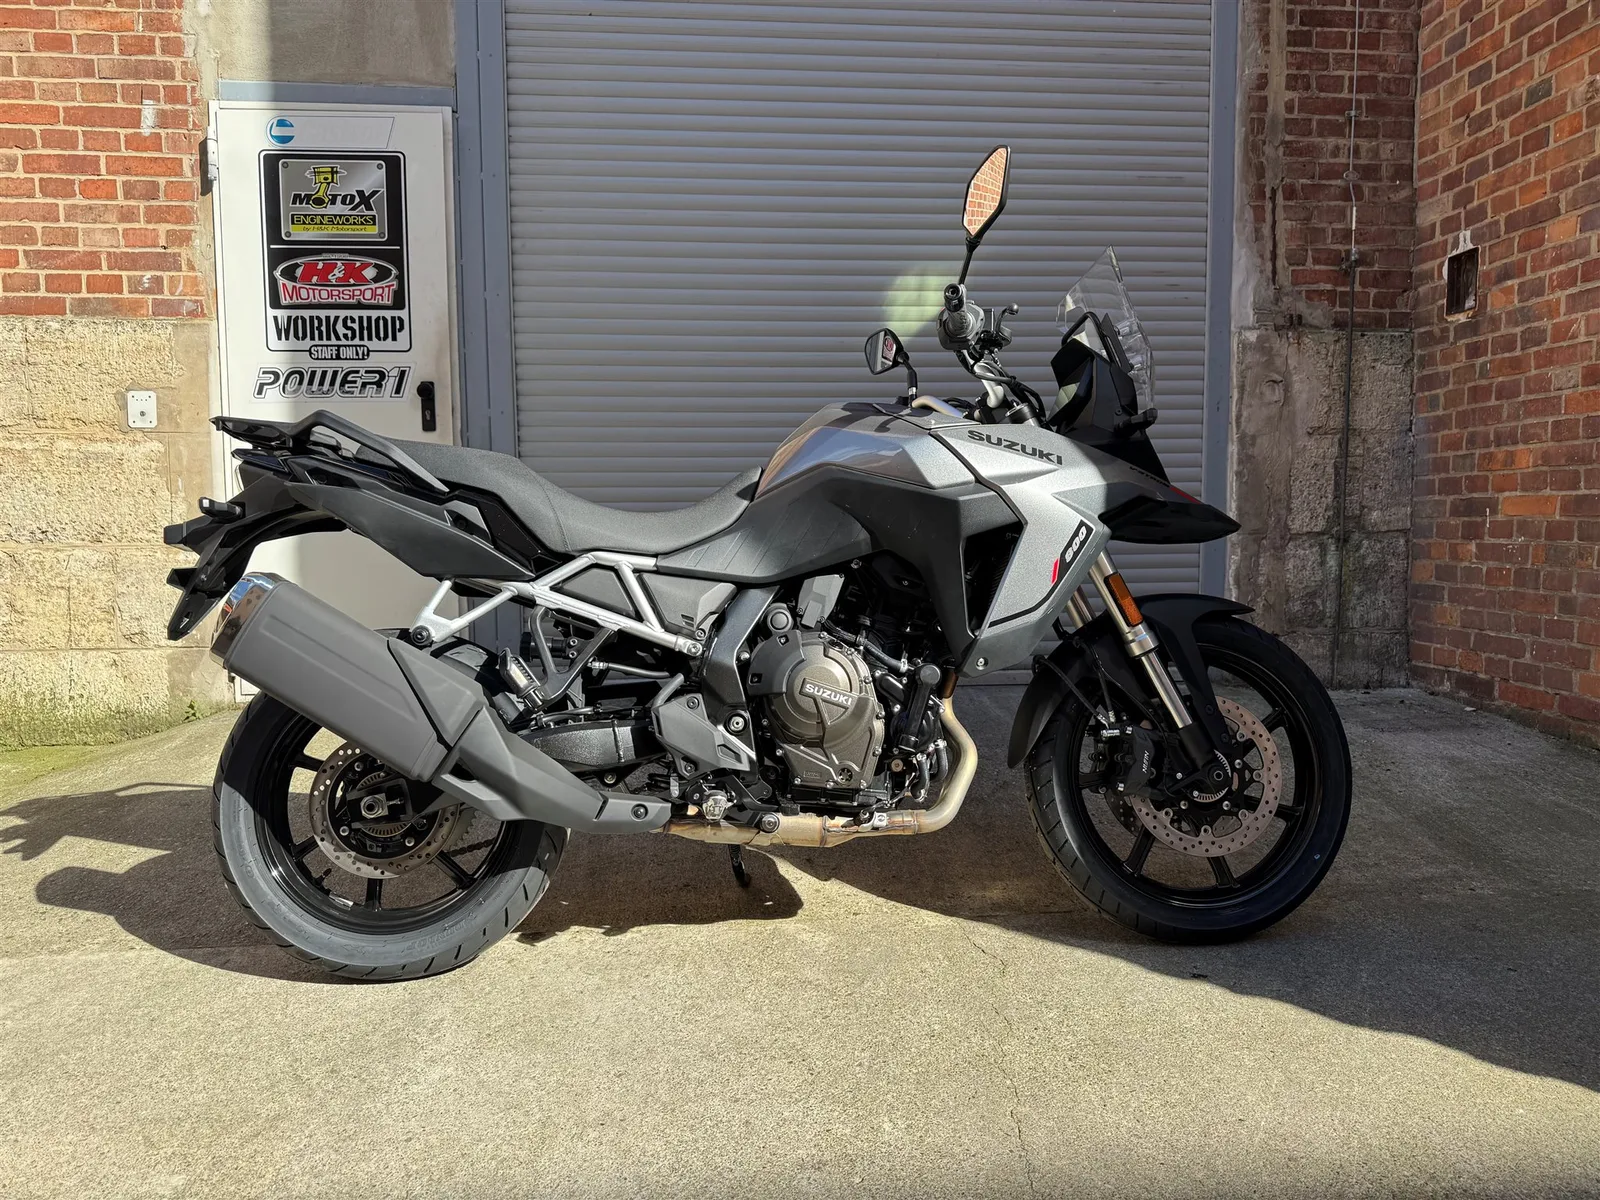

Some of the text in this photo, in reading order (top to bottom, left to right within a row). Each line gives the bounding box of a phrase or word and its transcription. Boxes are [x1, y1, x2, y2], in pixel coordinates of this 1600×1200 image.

[293, 215, 374, 225] ENGINEWORKS
[298, 261, 375, 284] H&K
[281, 283, 396, 303] MOTORSPORT
[273, 315, 405, 342] WORKSHOP
[311, 346, 368, 359] STAFF ONLY!
[253, 366, 411, 398] POWER1
[967, 429, 1063, 466] SUZUKI
[804, 683, 853, 706] SUZUKI
